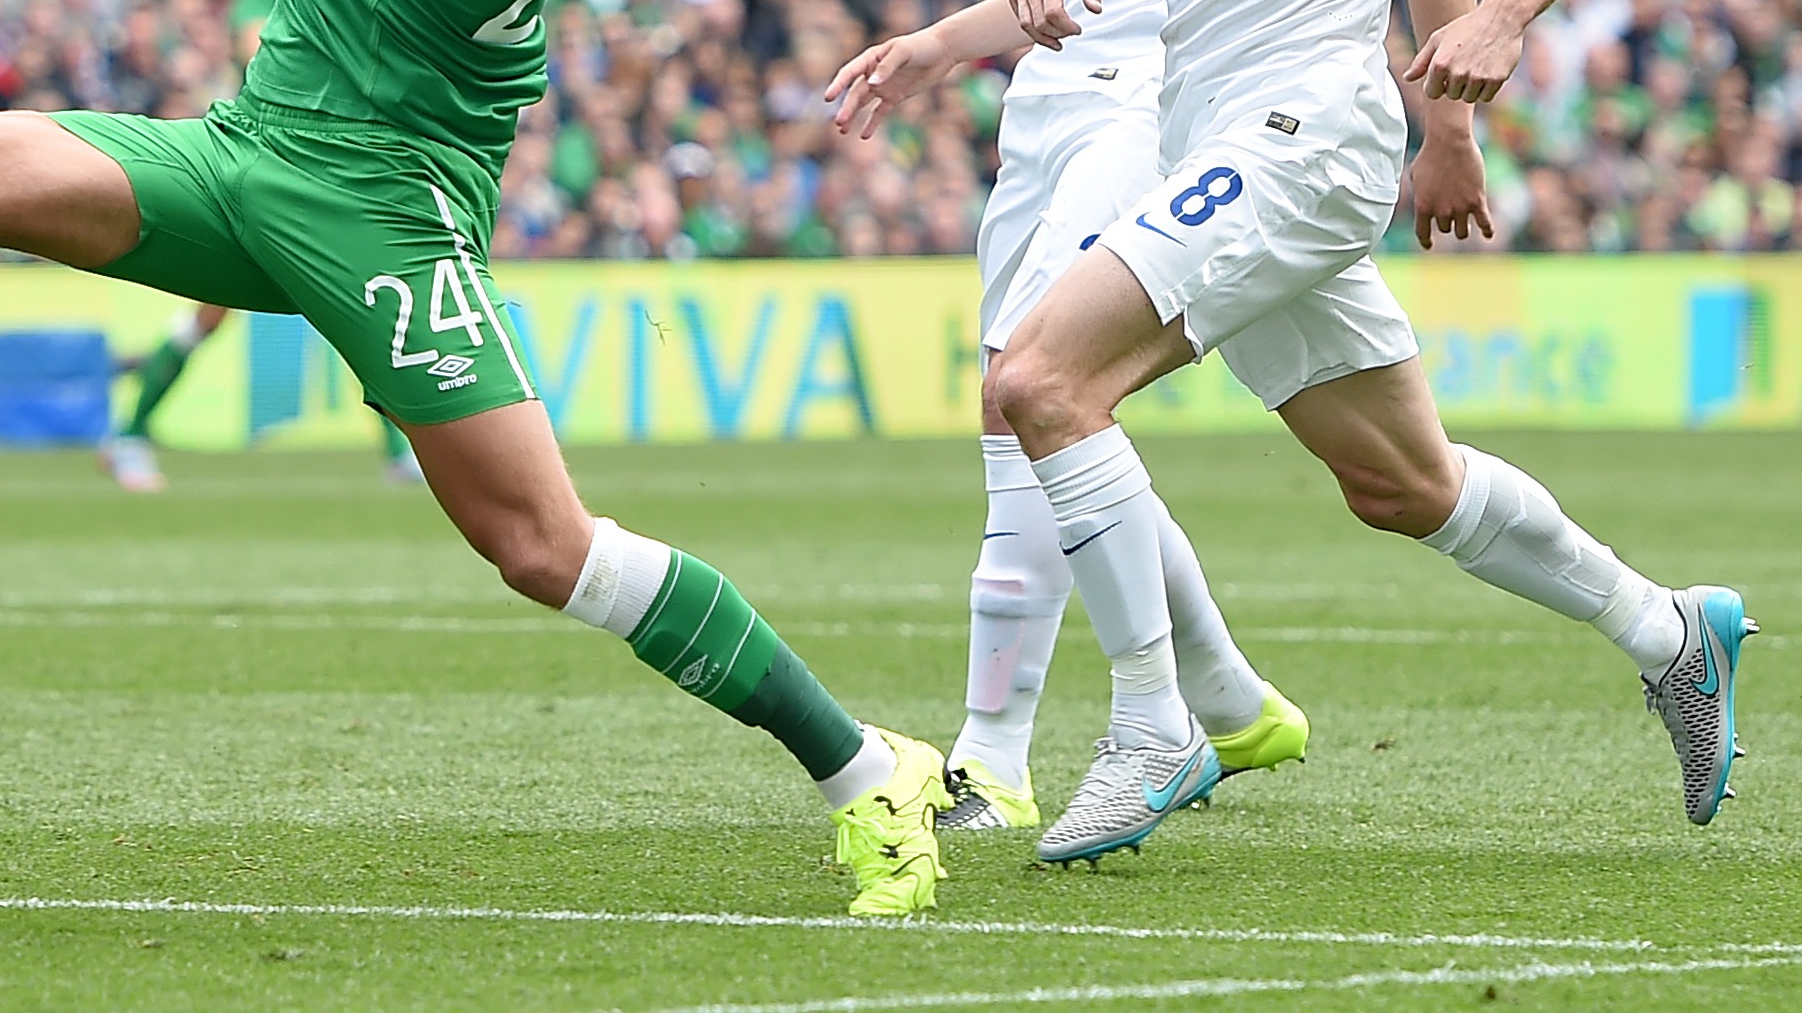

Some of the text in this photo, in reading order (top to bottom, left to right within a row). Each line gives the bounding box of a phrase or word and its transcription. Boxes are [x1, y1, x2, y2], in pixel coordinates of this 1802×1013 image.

[1169, 166, 1243, 226] 8
[364, 258, 484, 368] 24
[437, 373, 478, 391] umbro
